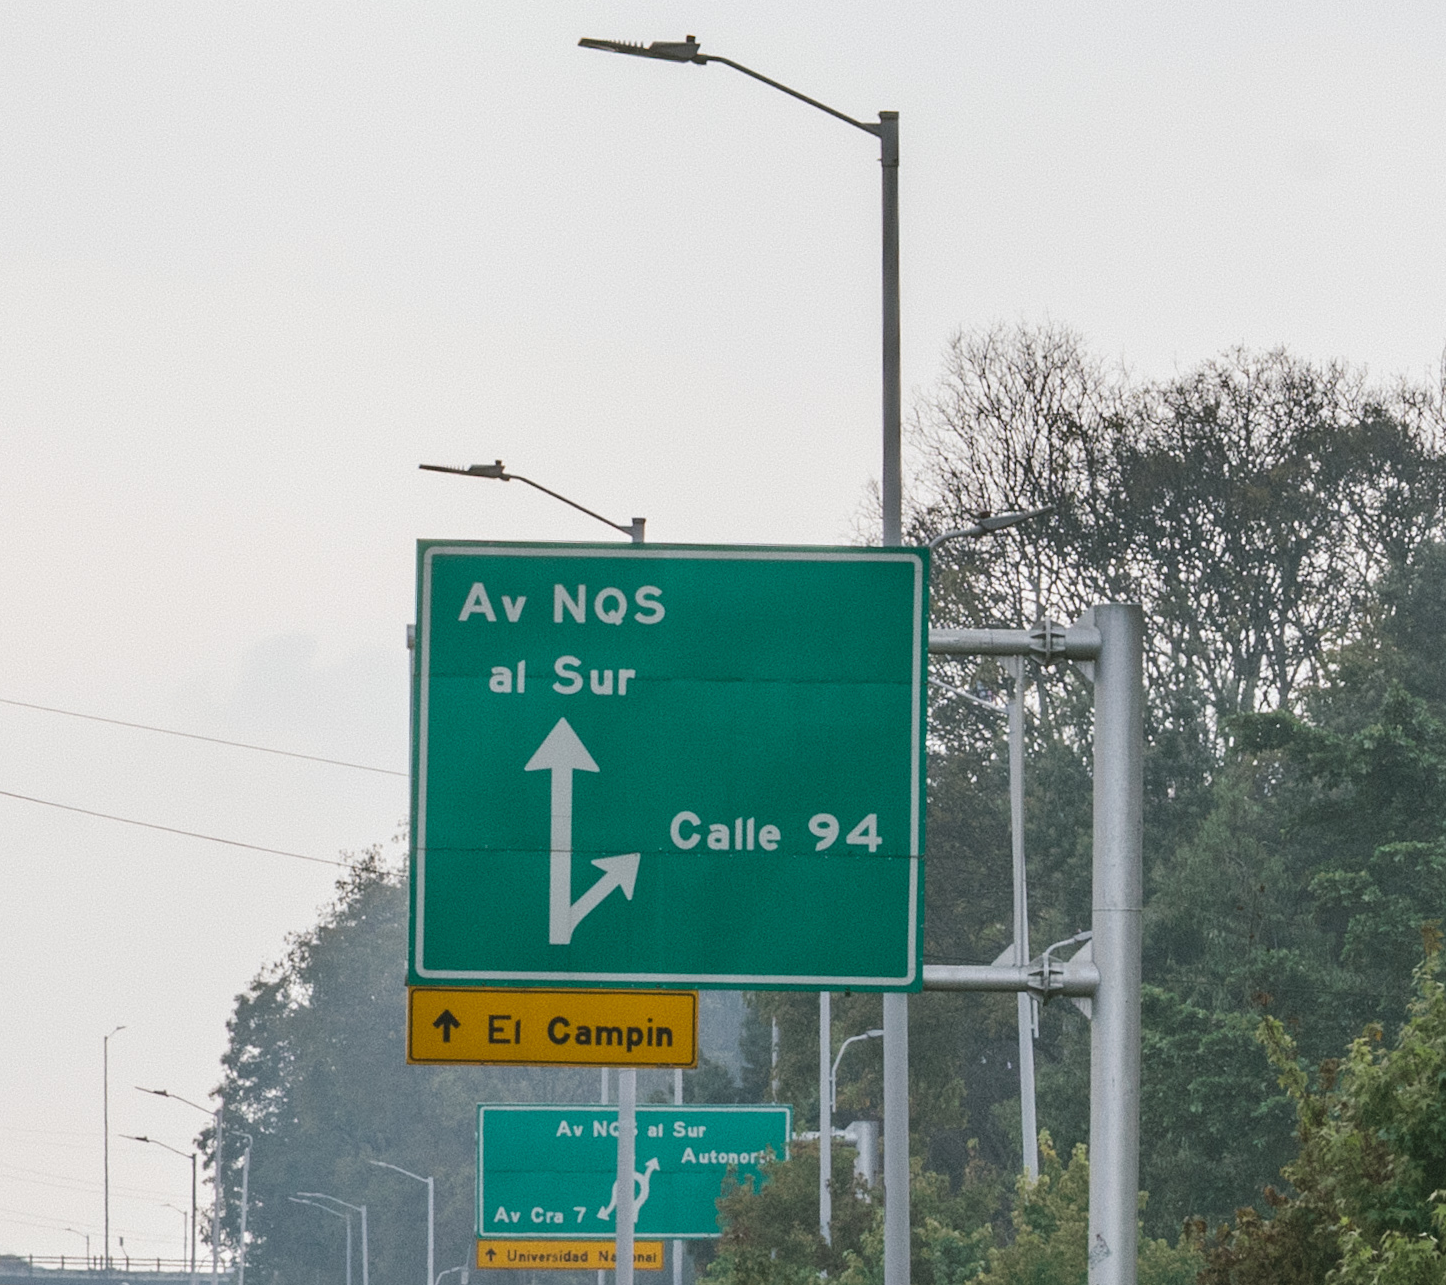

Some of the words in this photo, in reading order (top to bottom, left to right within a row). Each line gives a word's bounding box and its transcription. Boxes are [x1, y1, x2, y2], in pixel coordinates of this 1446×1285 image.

[458, 582, 527, 623] Av
[554, 584, 667, 626] NQS
[488, 659, 526, 694] al
[552, 655, 637, 696] Sur
[670, 810, 782, 851] Calle
[808, 813, 883, 853] 94
[488, 1015, 522, 1045] El
[547, 1016, 673, 1053] Campin
[556, 1120, 584, 1138] Av
[647, 1121, 664, 1138] al
[672, 1121, 707, 1139] Sur
[493, 1206, 521, 1223] Av
[530, 1206, 564, 1224] Cra
[572, 1206, 587, 1223] 7
[507, 1249, 588, 1263] Universidad
